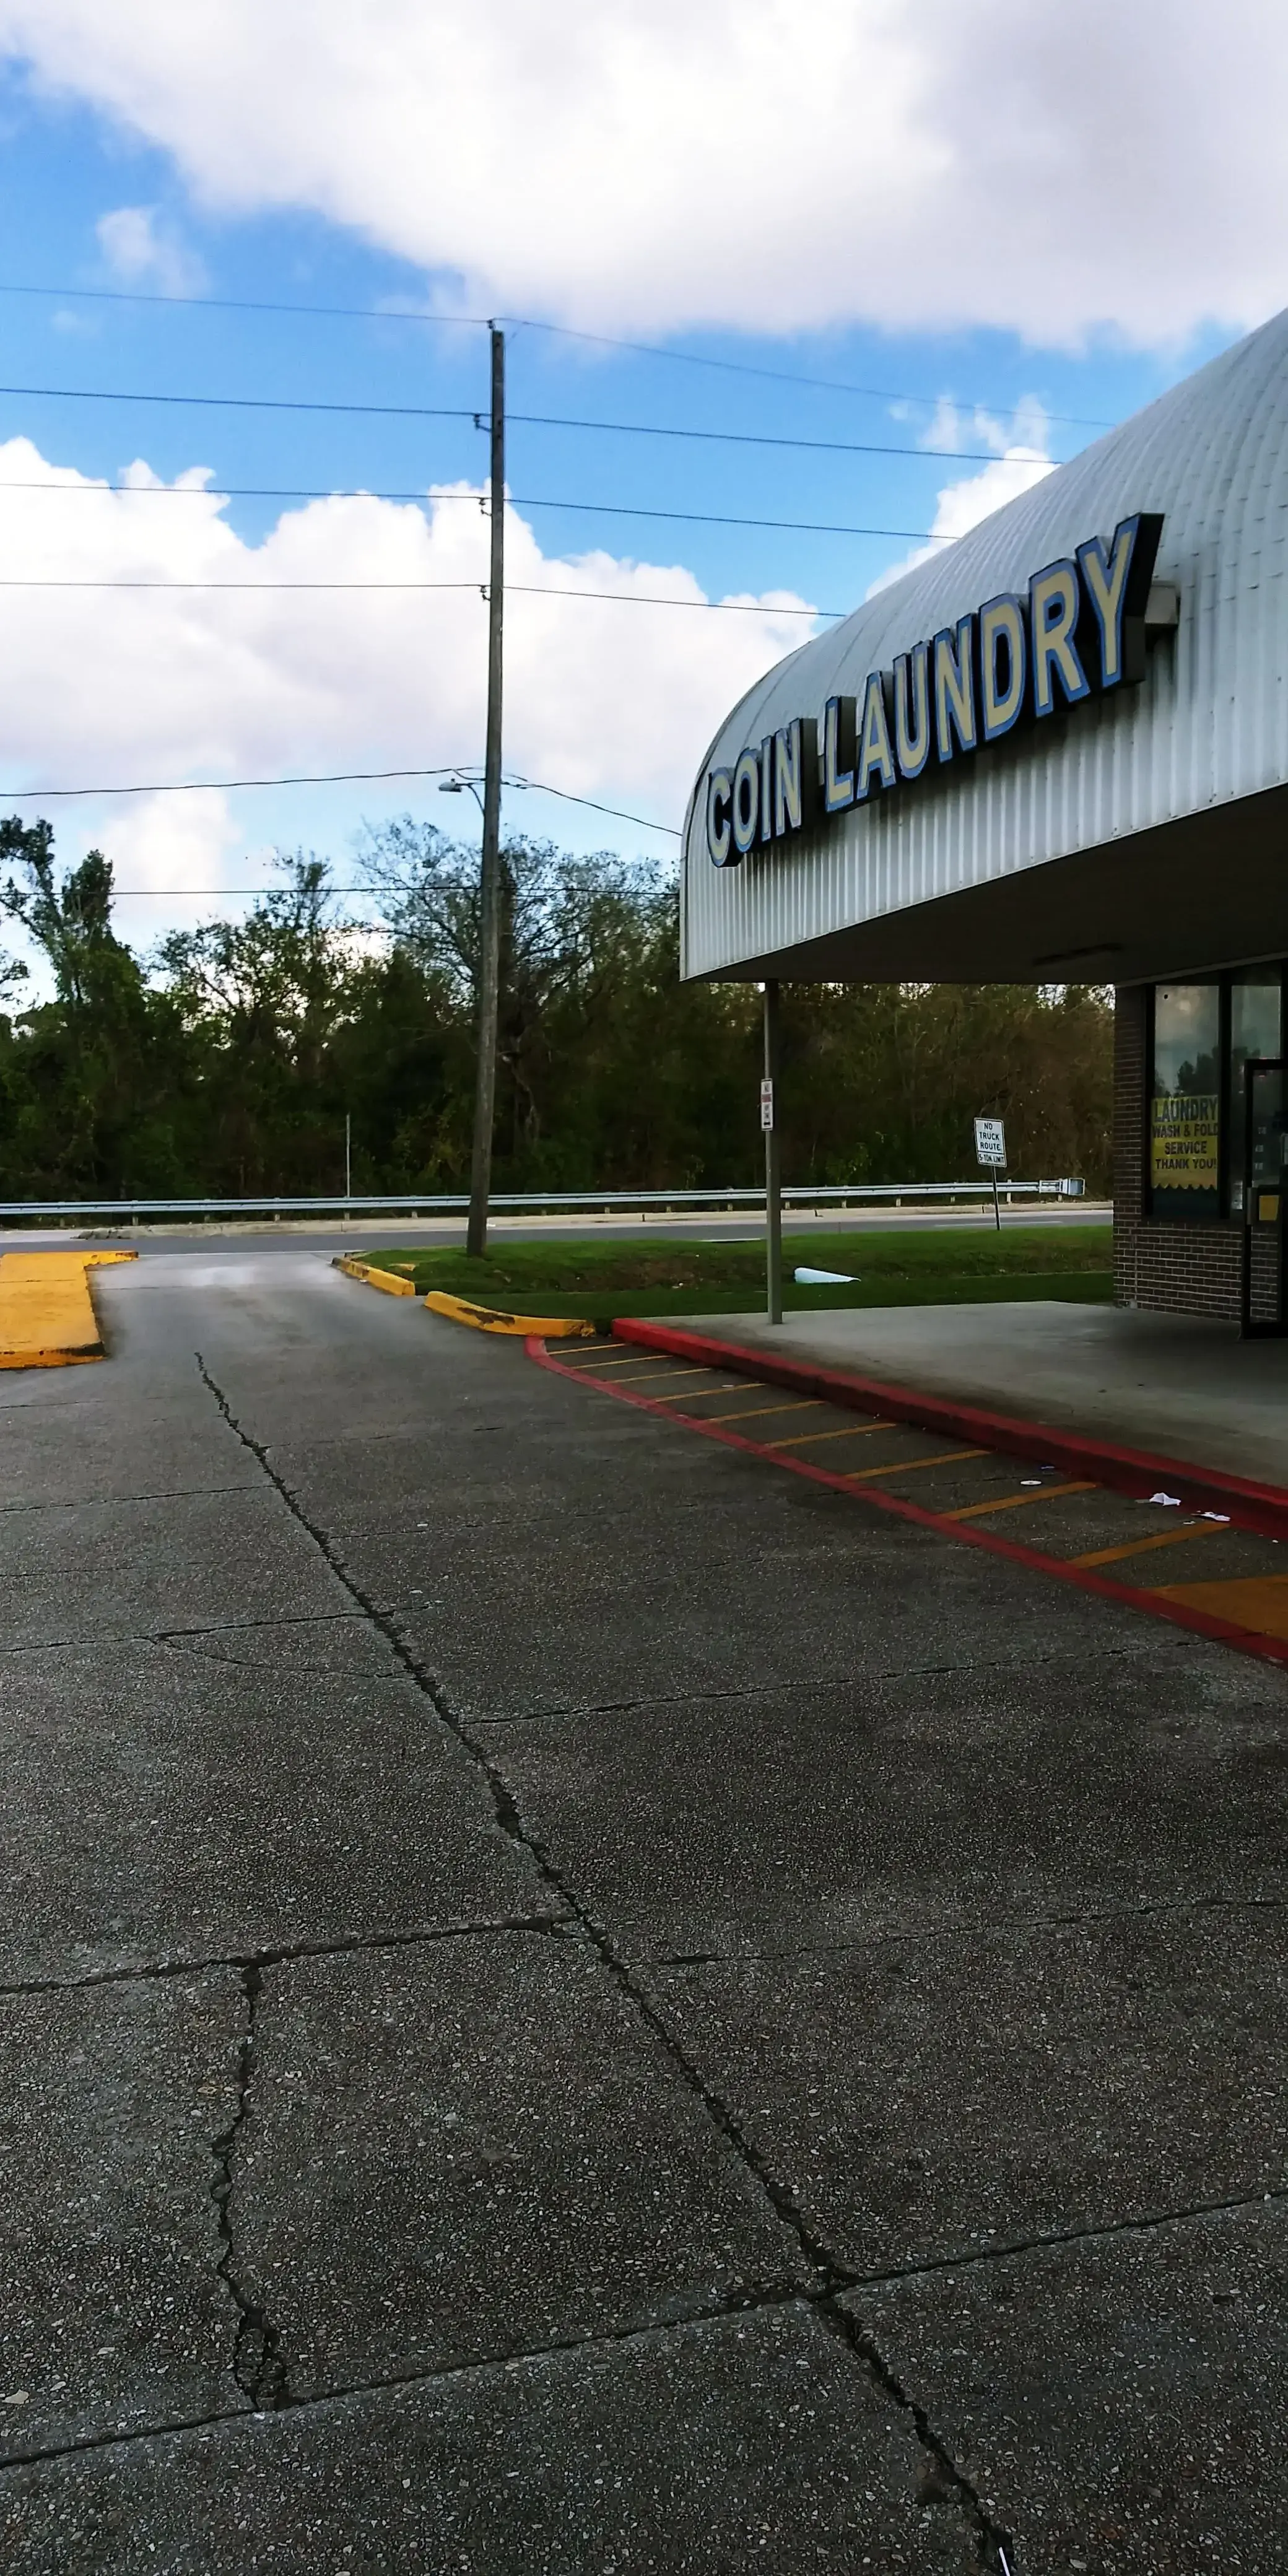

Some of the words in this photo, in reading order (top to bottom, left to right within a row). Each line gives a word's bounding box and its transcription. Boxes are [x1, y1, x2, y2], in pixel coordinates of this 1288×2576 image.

[707, 718, 803, 867] COIN
[825, 513, 1146, 814] LAUNDRY
[1154, 1098, 1217, 1122] LAUNDRY
[979, 1132, 999, 1141] TRUCK
[1152, 1125, 1180, 1138] WASH
[1183, 1124, 1191, 1137] &
[1194, 1123, 1218, 1137] FOLD
[980, 1142, 1001, 1151] ROUTE
[1165, 1141, 1208, 1155] SERVICE
[1155, 1159, 1189, 1169] THANK
[1193, 1158, 1217, 1169] YOU!
